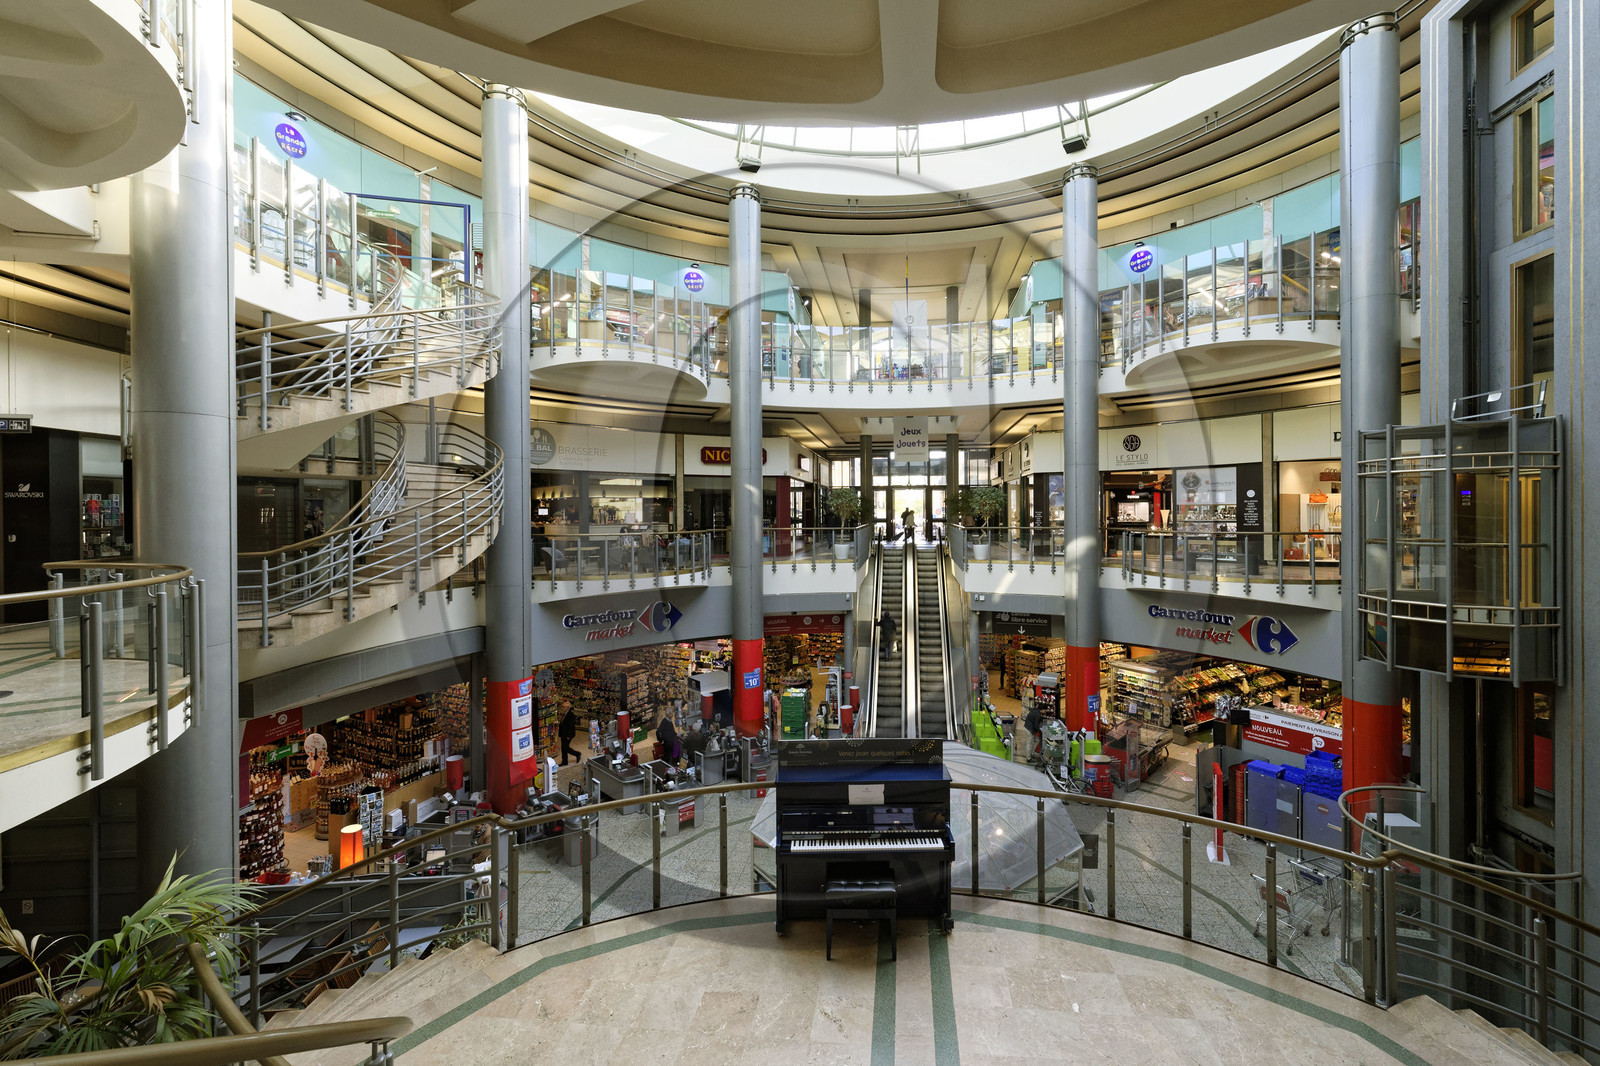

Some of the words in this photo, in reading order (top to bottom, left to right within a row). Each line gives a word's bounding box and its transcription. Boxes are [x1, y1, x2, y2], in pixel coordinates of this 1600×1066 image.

[285, 127, 295, 136] La
[276, 132, 306, 148] Grande
[281, 142, 304, 155] Récré
[1130, 255, 1152, 266] Grande
[901, 427, 922, 436] Jeux
[536, 444, 552, 452] BAL
[896, 440, 926, 448] Jouets
[558, 446, 608, 457] BRASSERIE
[1126, 453, 1149, 461] STYLO
[562, 608, 637, 629] Carrefour
[1147, 604, 1236, 626] Carrefour
[584, 622, 636, 641] market
[1175, 626, 1235, 644] market
[1251, 724, 1283, 736] NOUVEAU
[1281, 719, 1306, 731] PAIEMENT
[1311, 726, 1340, 738] LIVRAISON
[870, 750, 895, 758] quelques
